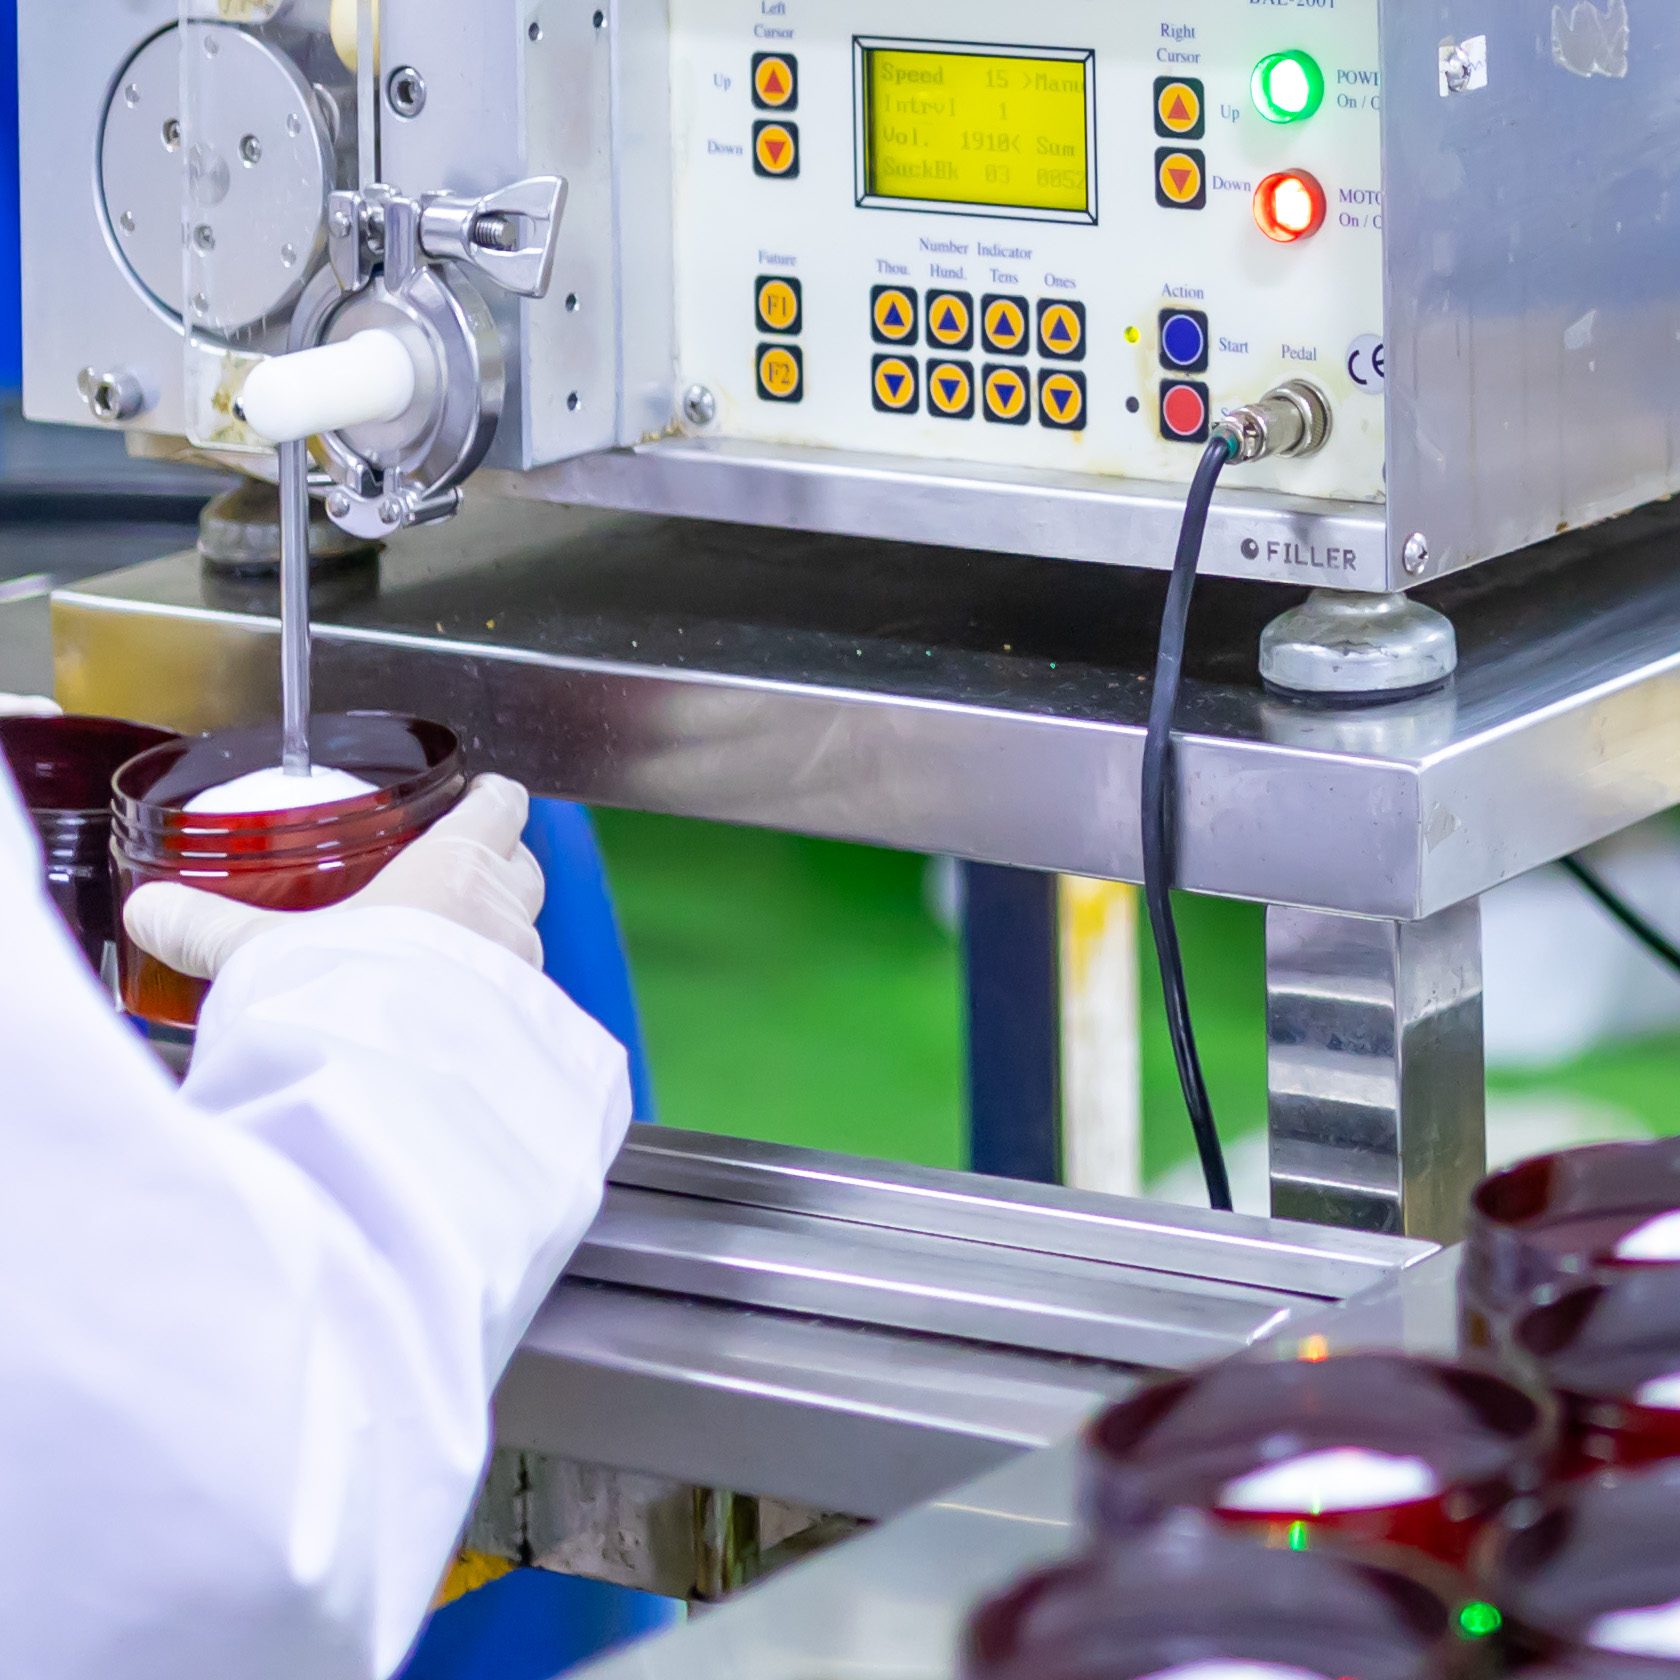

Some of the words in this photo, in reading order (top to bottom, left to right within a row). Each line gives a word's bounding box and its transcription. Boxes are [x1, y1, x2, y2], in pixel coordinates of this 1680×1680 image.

[761, 0, 786, 16] Left
[753, 24, 795, 39] Cursor
[1160, 22, 1196, 42] Right
[1156, 48, 1201, 65] Cursor
[713, 73, 732, 91] Up
[880, 61, 944, 86] Speed
[986, 68, 1009, 89] 15
[1337, 93, 1358, 109] On
[1220, 104, 1240, 123] Up
[882, 126, 929, 148] Vol.
[707, 140, 744, 156] Down
[1212, 174, 1252, 192] Down
[1338, 211, 1360, 228] On
[919, 236, 970, 256] Number
[977, 242, 1033, 261] Indicator
[758, 249, 797, 267] Future
[876, 258, 911, 276] Thou.
[929, 263, 966, 281] Hund.
[989, 268, 1020, 284] Tens
[1044, 272, 1077, 290] Ones
[1161, 282, 1205, 300] Action
[766, 293, 788, 318] F1
[1219, 336, 1250, 354] Start
[1281, 343, 1318, 362] Pedal
[768, 360, 791, 385] F2
[1266, 539, 1358, 572] FILLER
